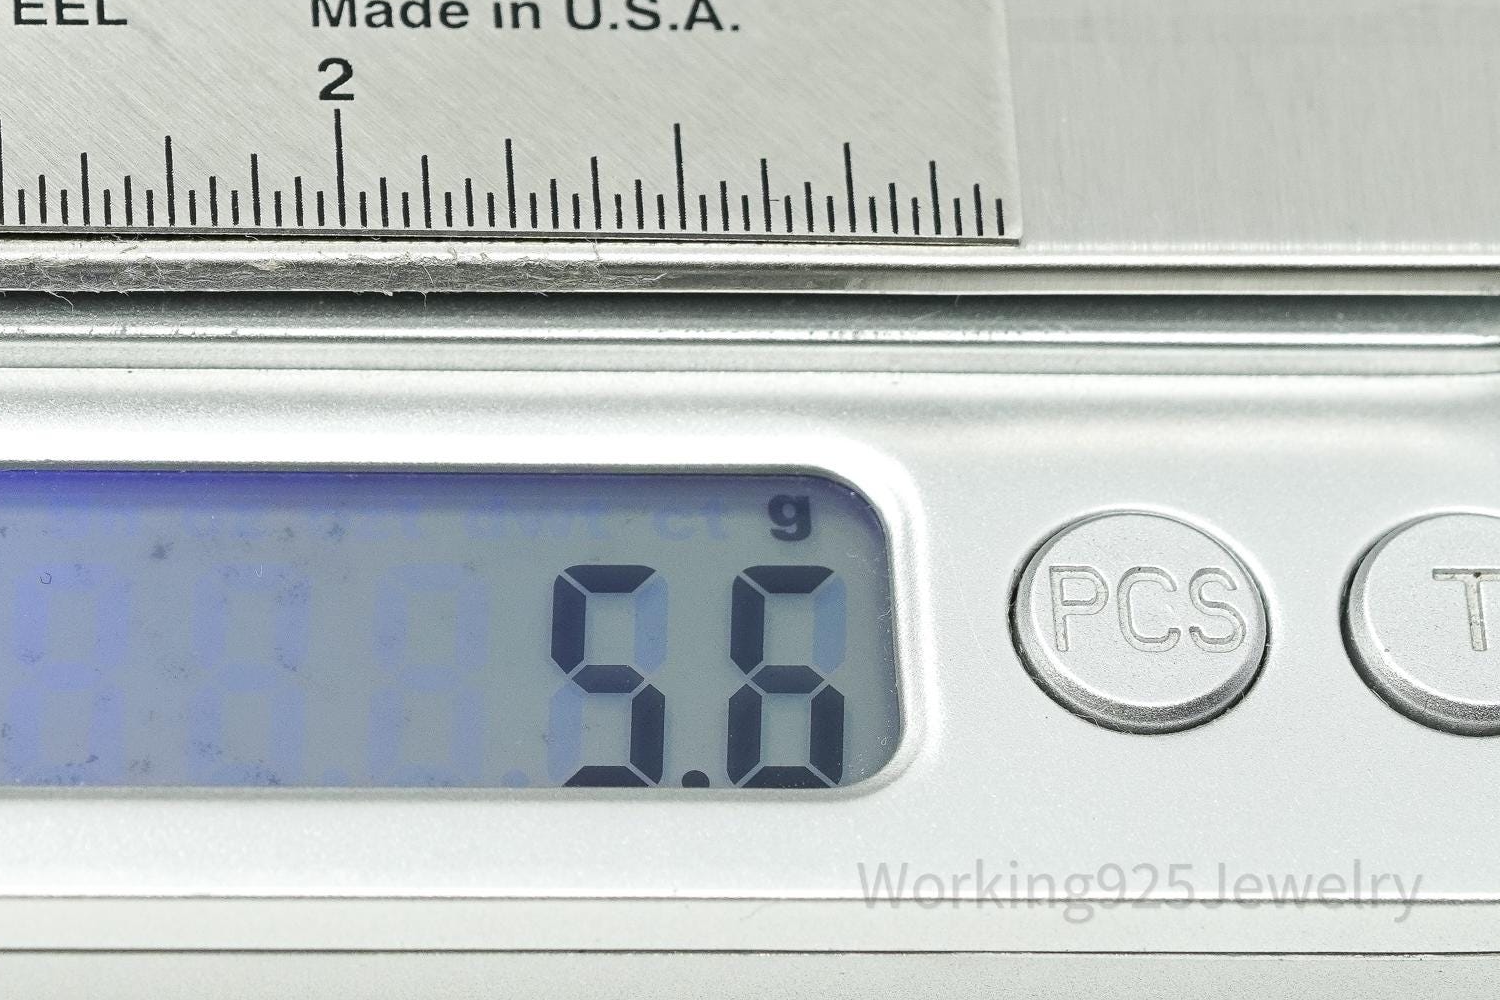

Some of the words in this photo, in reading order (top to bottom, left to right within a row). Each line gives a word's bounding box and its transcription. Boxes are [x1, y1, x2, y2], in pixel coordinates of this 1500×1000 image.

[317, 56, 355, 101] 2
[766, 494, 813, 542] g
[1047, 564, 1248, 654] PCS
[550, 564, 846, 790] 5.6
